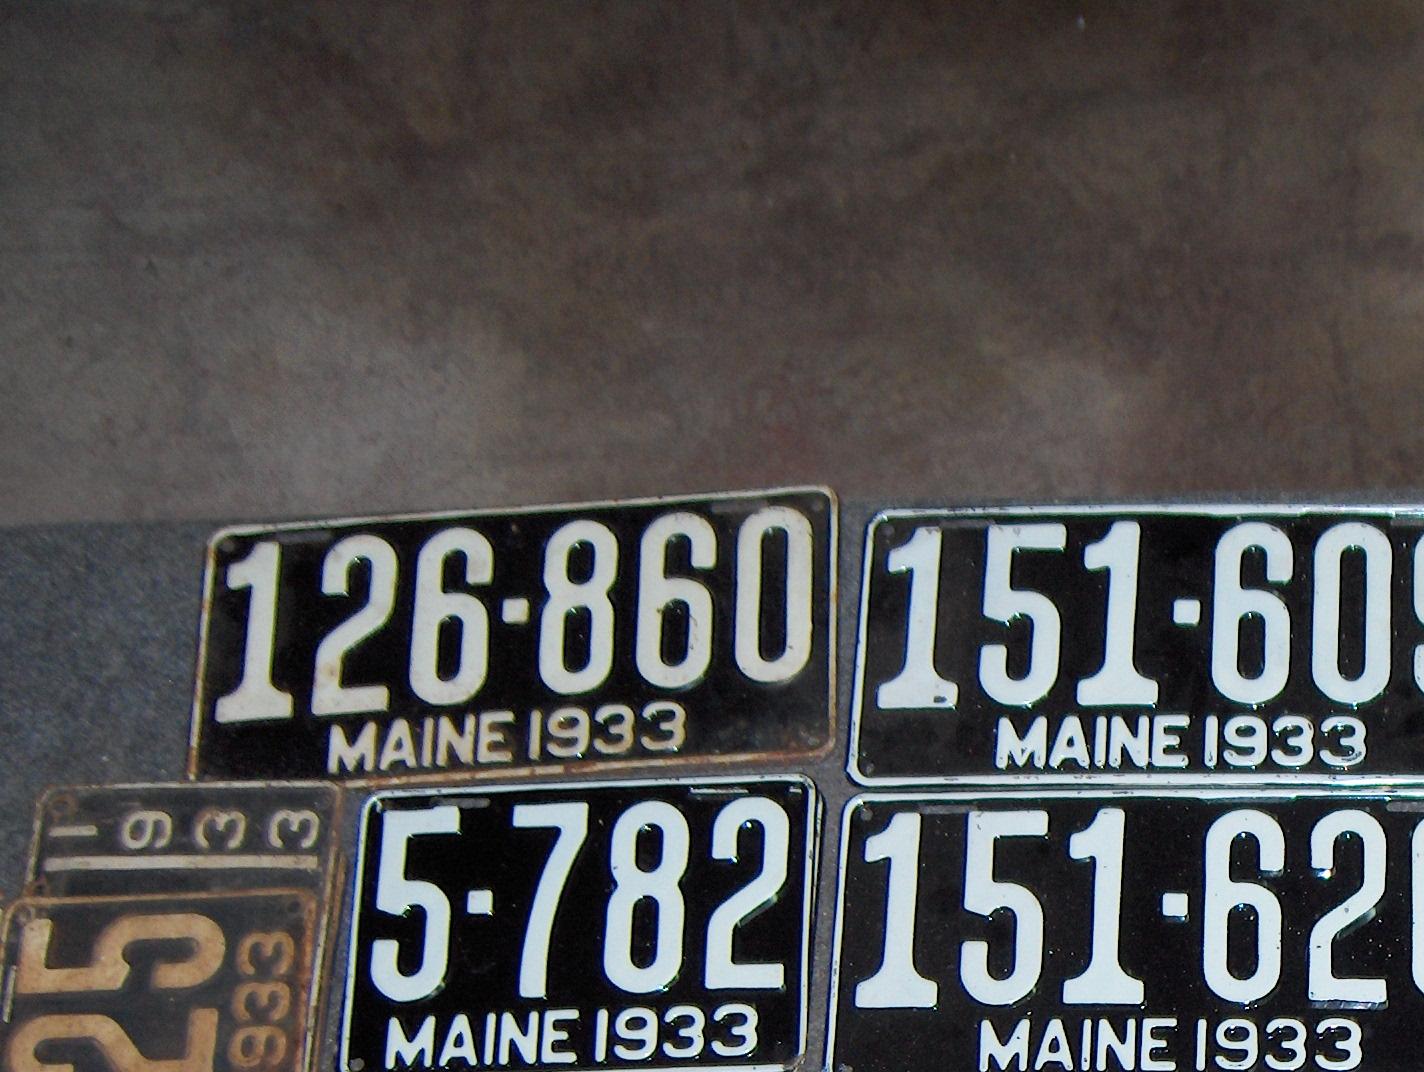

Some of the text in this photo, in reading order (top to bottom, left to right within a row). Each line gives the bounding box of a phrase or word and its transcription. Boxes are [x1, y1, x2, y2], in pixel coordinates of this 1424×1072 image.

[326, 701, 687, 774] MAINE 1933
[994, 714, 1367, 769] MAINE 1933
[384, 1003, 759, 1070] MAINE 1933
[979, 1017, 1363, 1072] MAINE 1933
